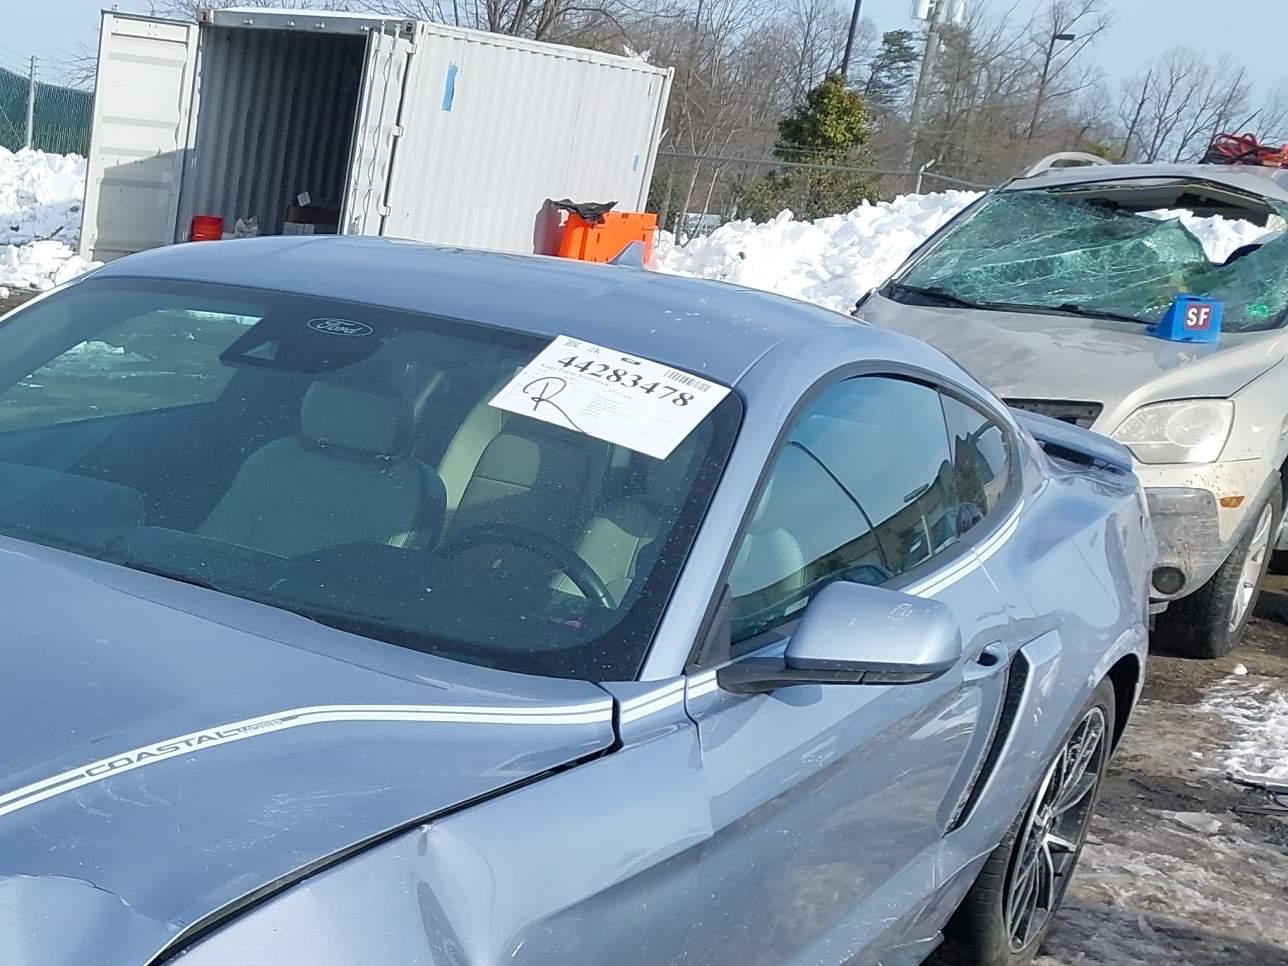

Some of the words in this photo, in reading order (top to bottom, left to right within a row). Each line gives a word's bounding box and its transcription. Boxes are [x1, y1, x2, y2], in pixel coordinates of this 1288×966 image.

[316, 320, 363, 335] Ford
[1187, 307, 1210, 326] SF
[558, 355, 694, 408] 44283478
[86, 729, 240, 777] COASTAL
